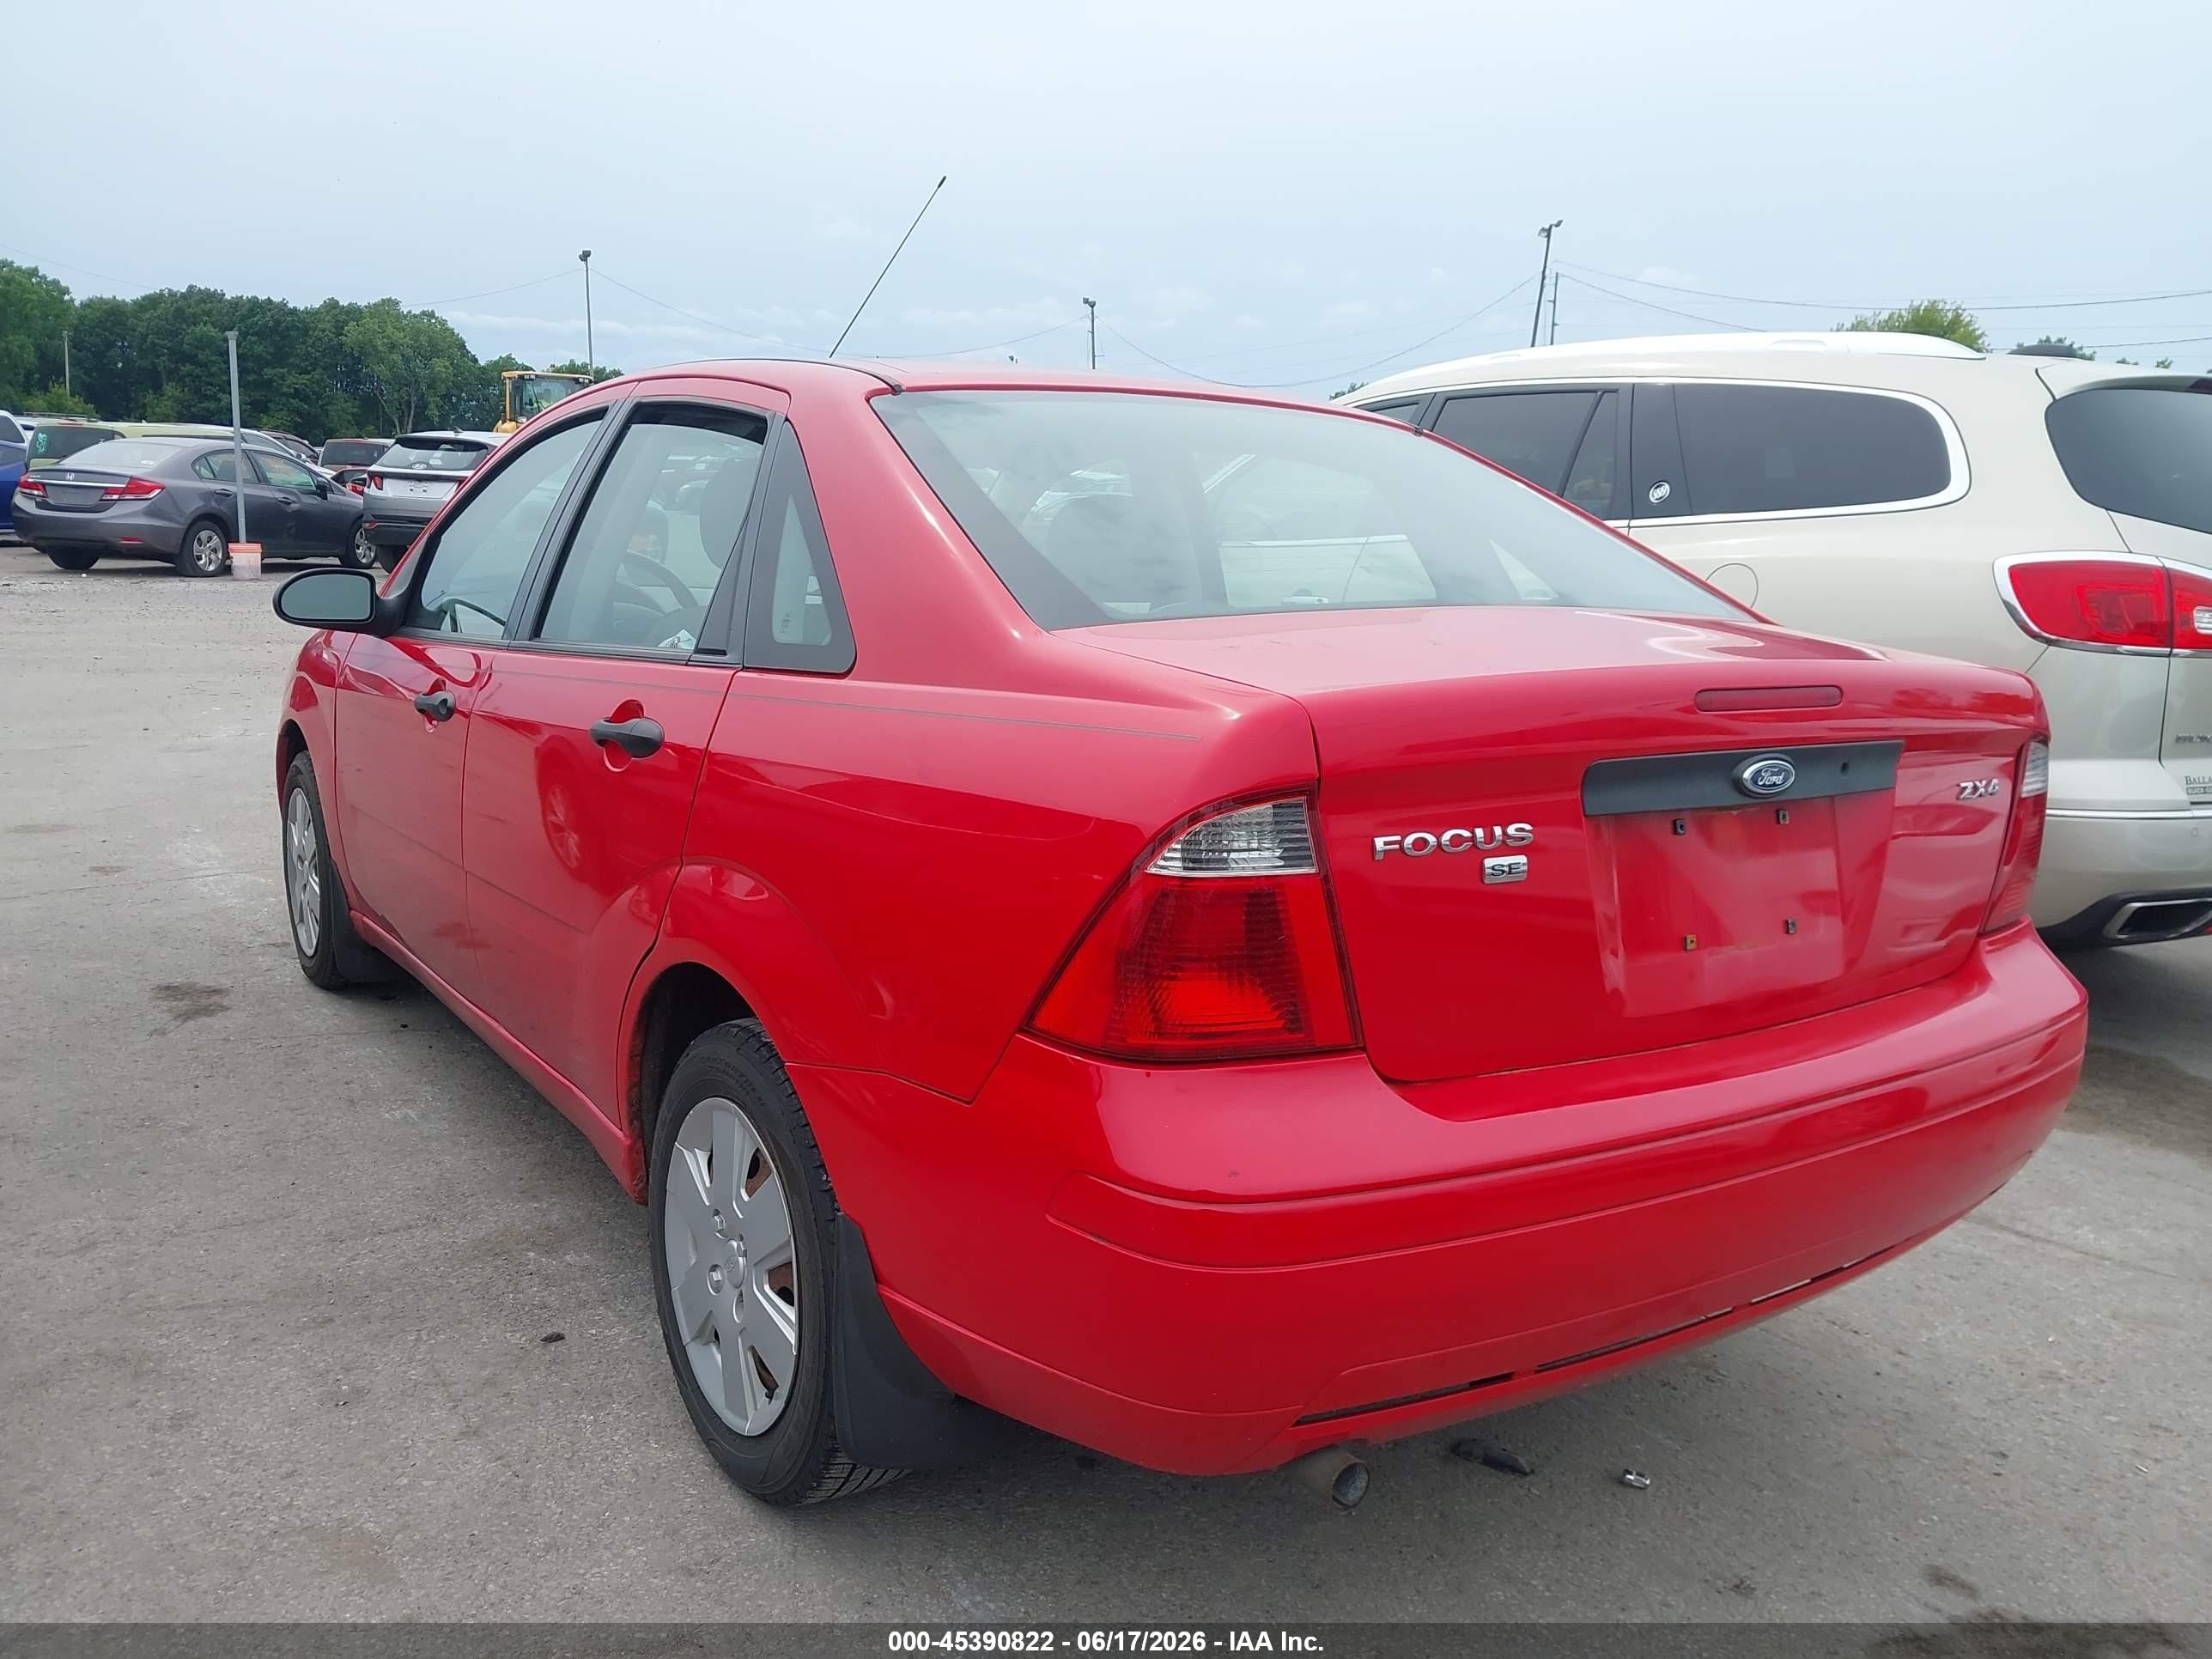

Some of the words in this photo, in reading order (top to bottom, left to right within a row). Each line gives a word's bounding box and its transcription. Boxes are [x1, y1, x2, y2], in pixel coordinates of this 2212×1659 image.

[1958, 778, 1999, 800] ZX4
[1373, 823, 1534, 860] FOCUS
[1490, 862, 1523, 878] SE
